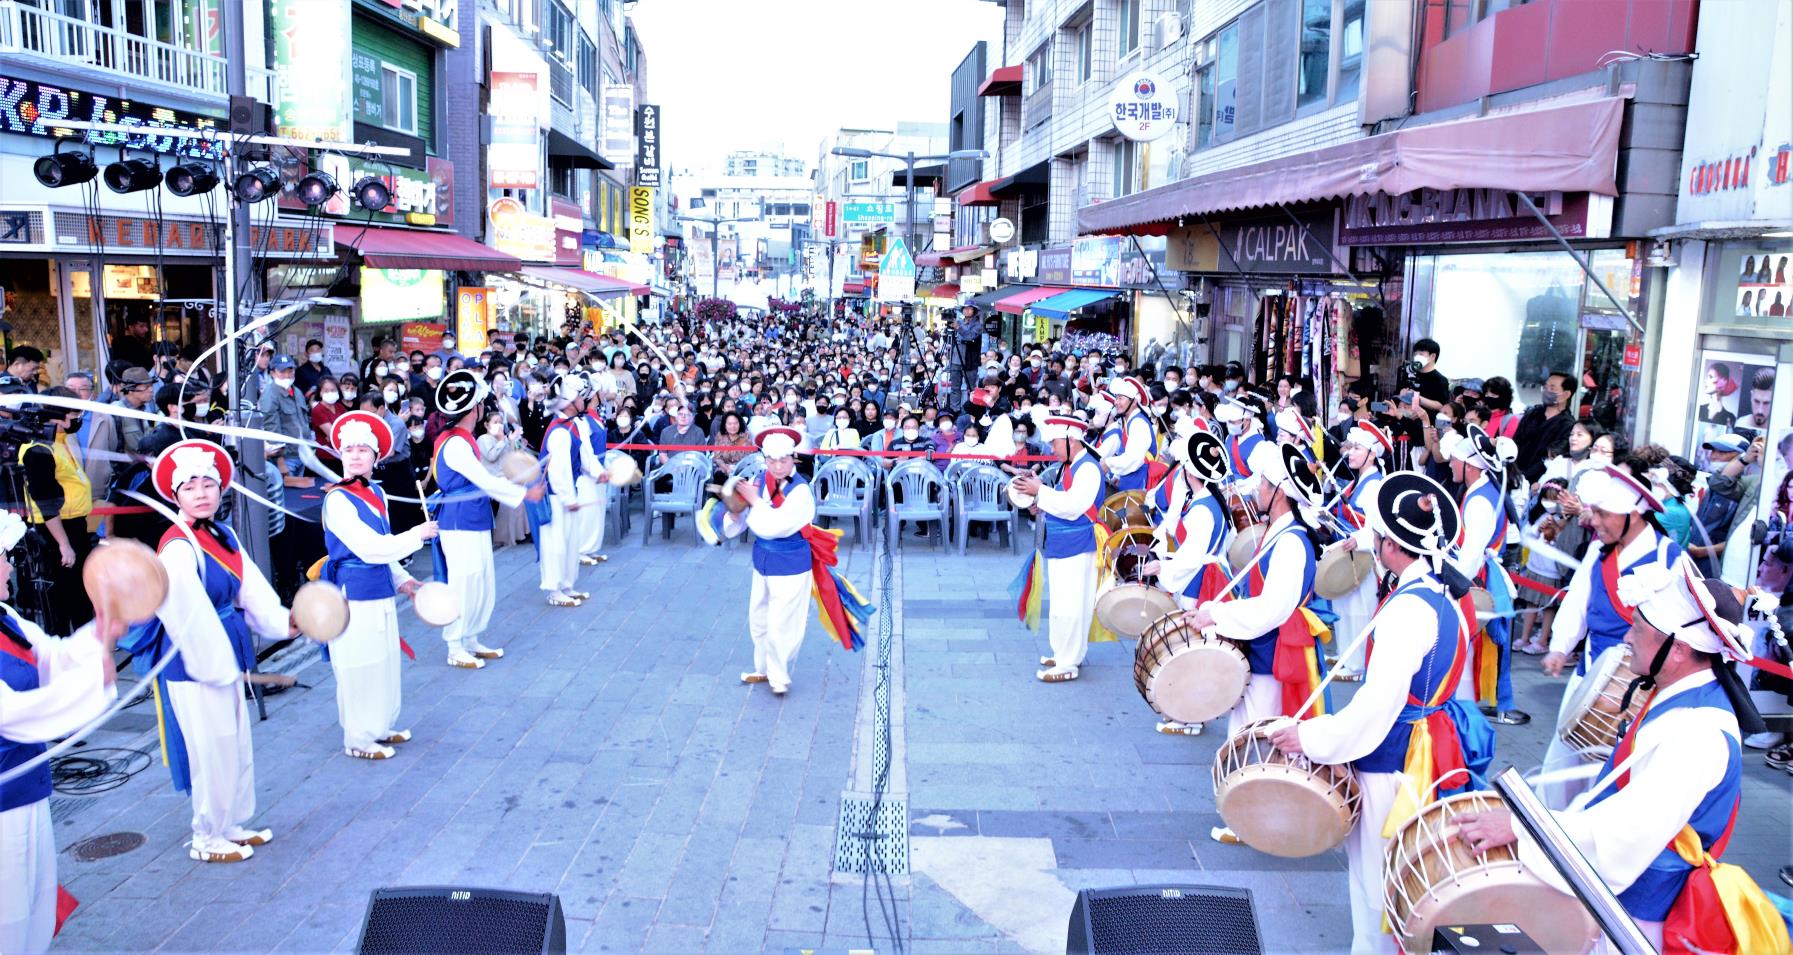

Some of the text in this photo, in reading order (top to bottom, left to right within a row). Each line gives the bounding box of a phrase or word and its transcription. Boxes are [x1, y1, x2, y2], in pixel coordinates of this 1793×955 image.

[1116, 102, 1175, 120] 한국개발(주)
[1139, 121, 1151, 131] 2F
[1245, 223, 1312, 263] CALPAK
